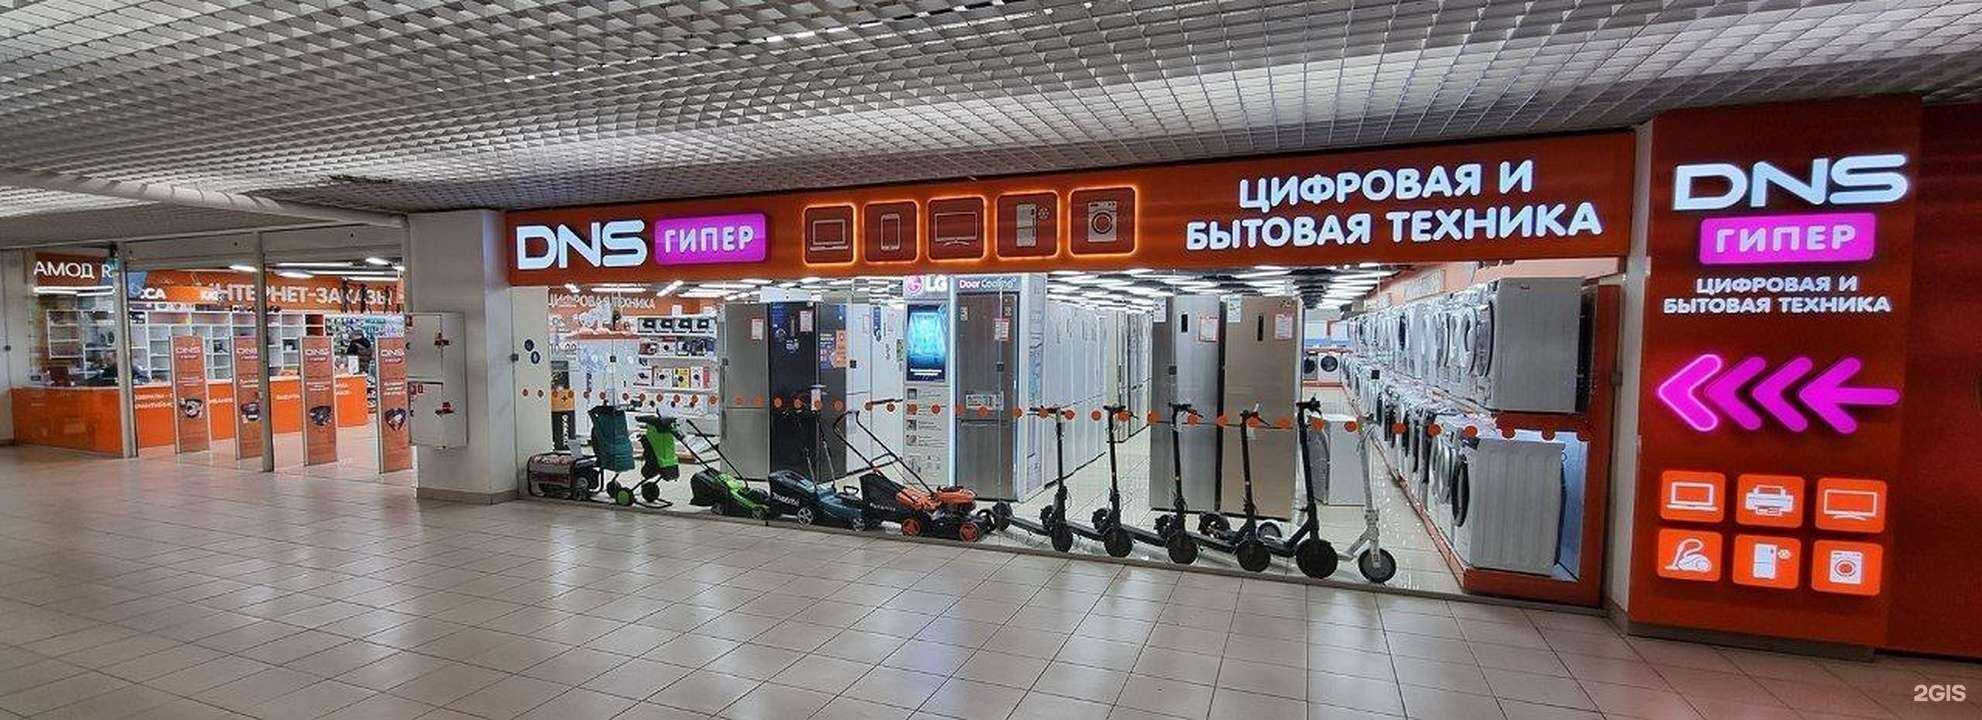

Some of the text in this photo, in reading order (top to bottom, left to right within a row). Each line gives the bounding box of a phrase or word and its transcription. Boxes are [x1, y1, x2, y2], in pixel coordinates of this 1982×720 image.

[1239, 159, 1533, 213] ЦИФРОВАЯ И
[1673, 154, 1909, 211] DNS
[664, 225, 755, 254] ГИПЕР
[1186, 201, 1603, 250] БЫТОВАЯ ТЕХНИКА
[1716, 224, 1857, 253] ГИПЕР
[516, 219, 648, 270] DNS
[925, 275, 948, 292] LG
[959, 279, 980, 289] Door
[1696, 275, 1857, 296] ЦИФРОВАЯ И
[1663, 296, 1892, 314] БЫТОВАЯ ТЕХНИКА
